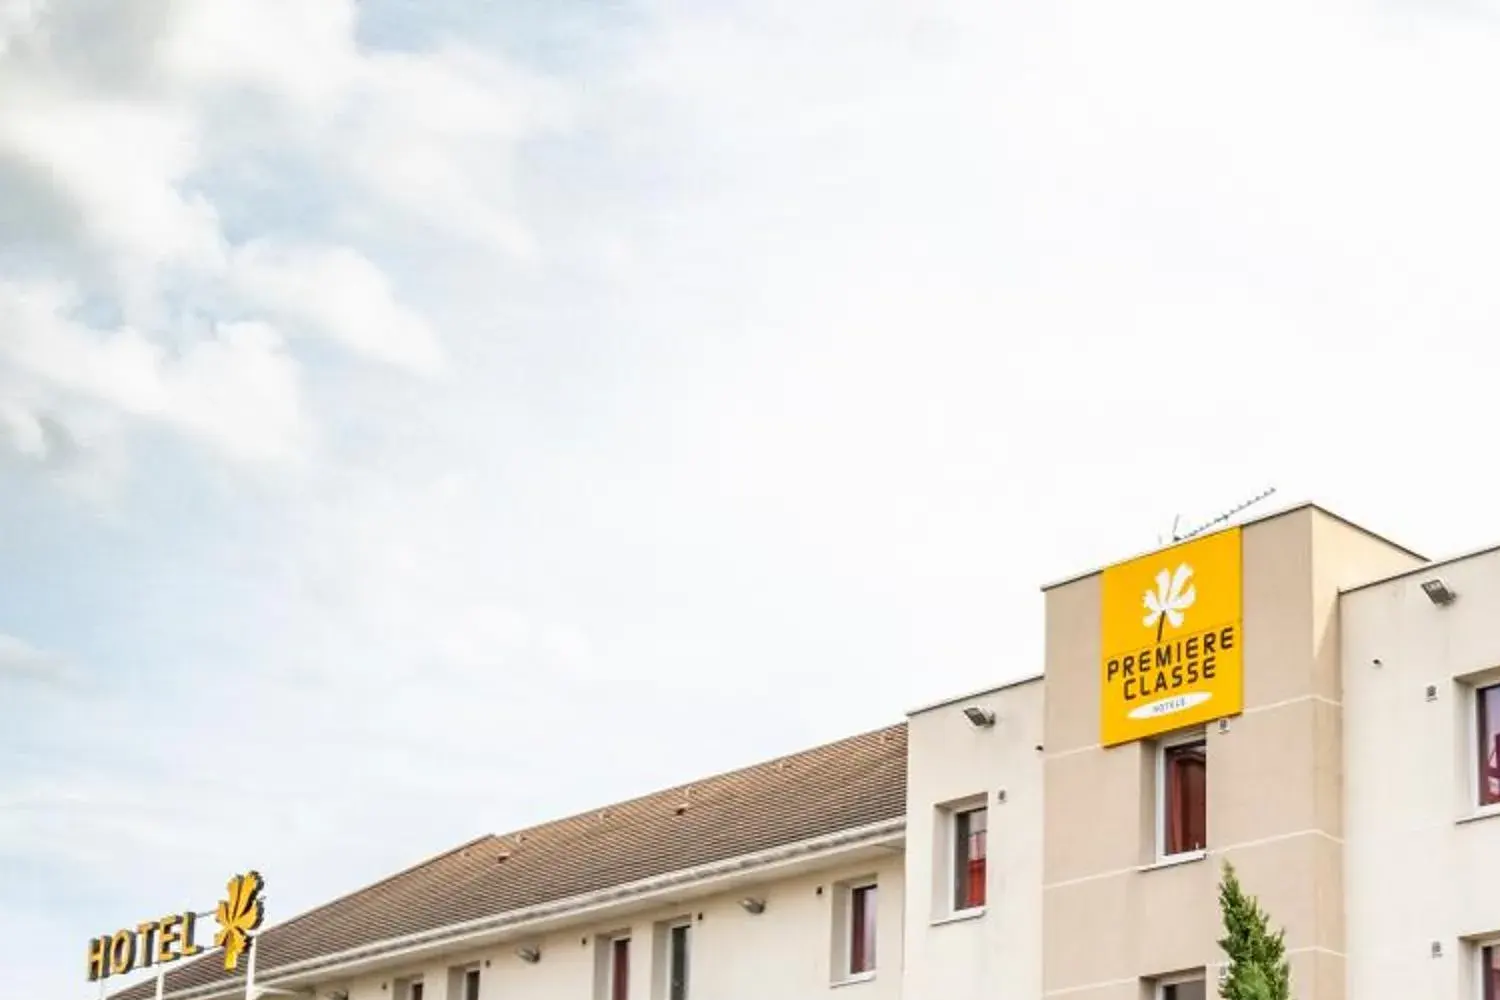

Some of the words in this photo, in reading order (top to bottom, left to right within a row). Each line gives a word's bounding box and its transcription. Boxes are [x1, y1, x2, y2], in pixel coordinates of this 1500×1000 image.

[1107, 626, 1234, 682] PREMIERE
[1123, 656, 1216, 701] CLASSE
[87, 911, 203, 982] HOTEL
